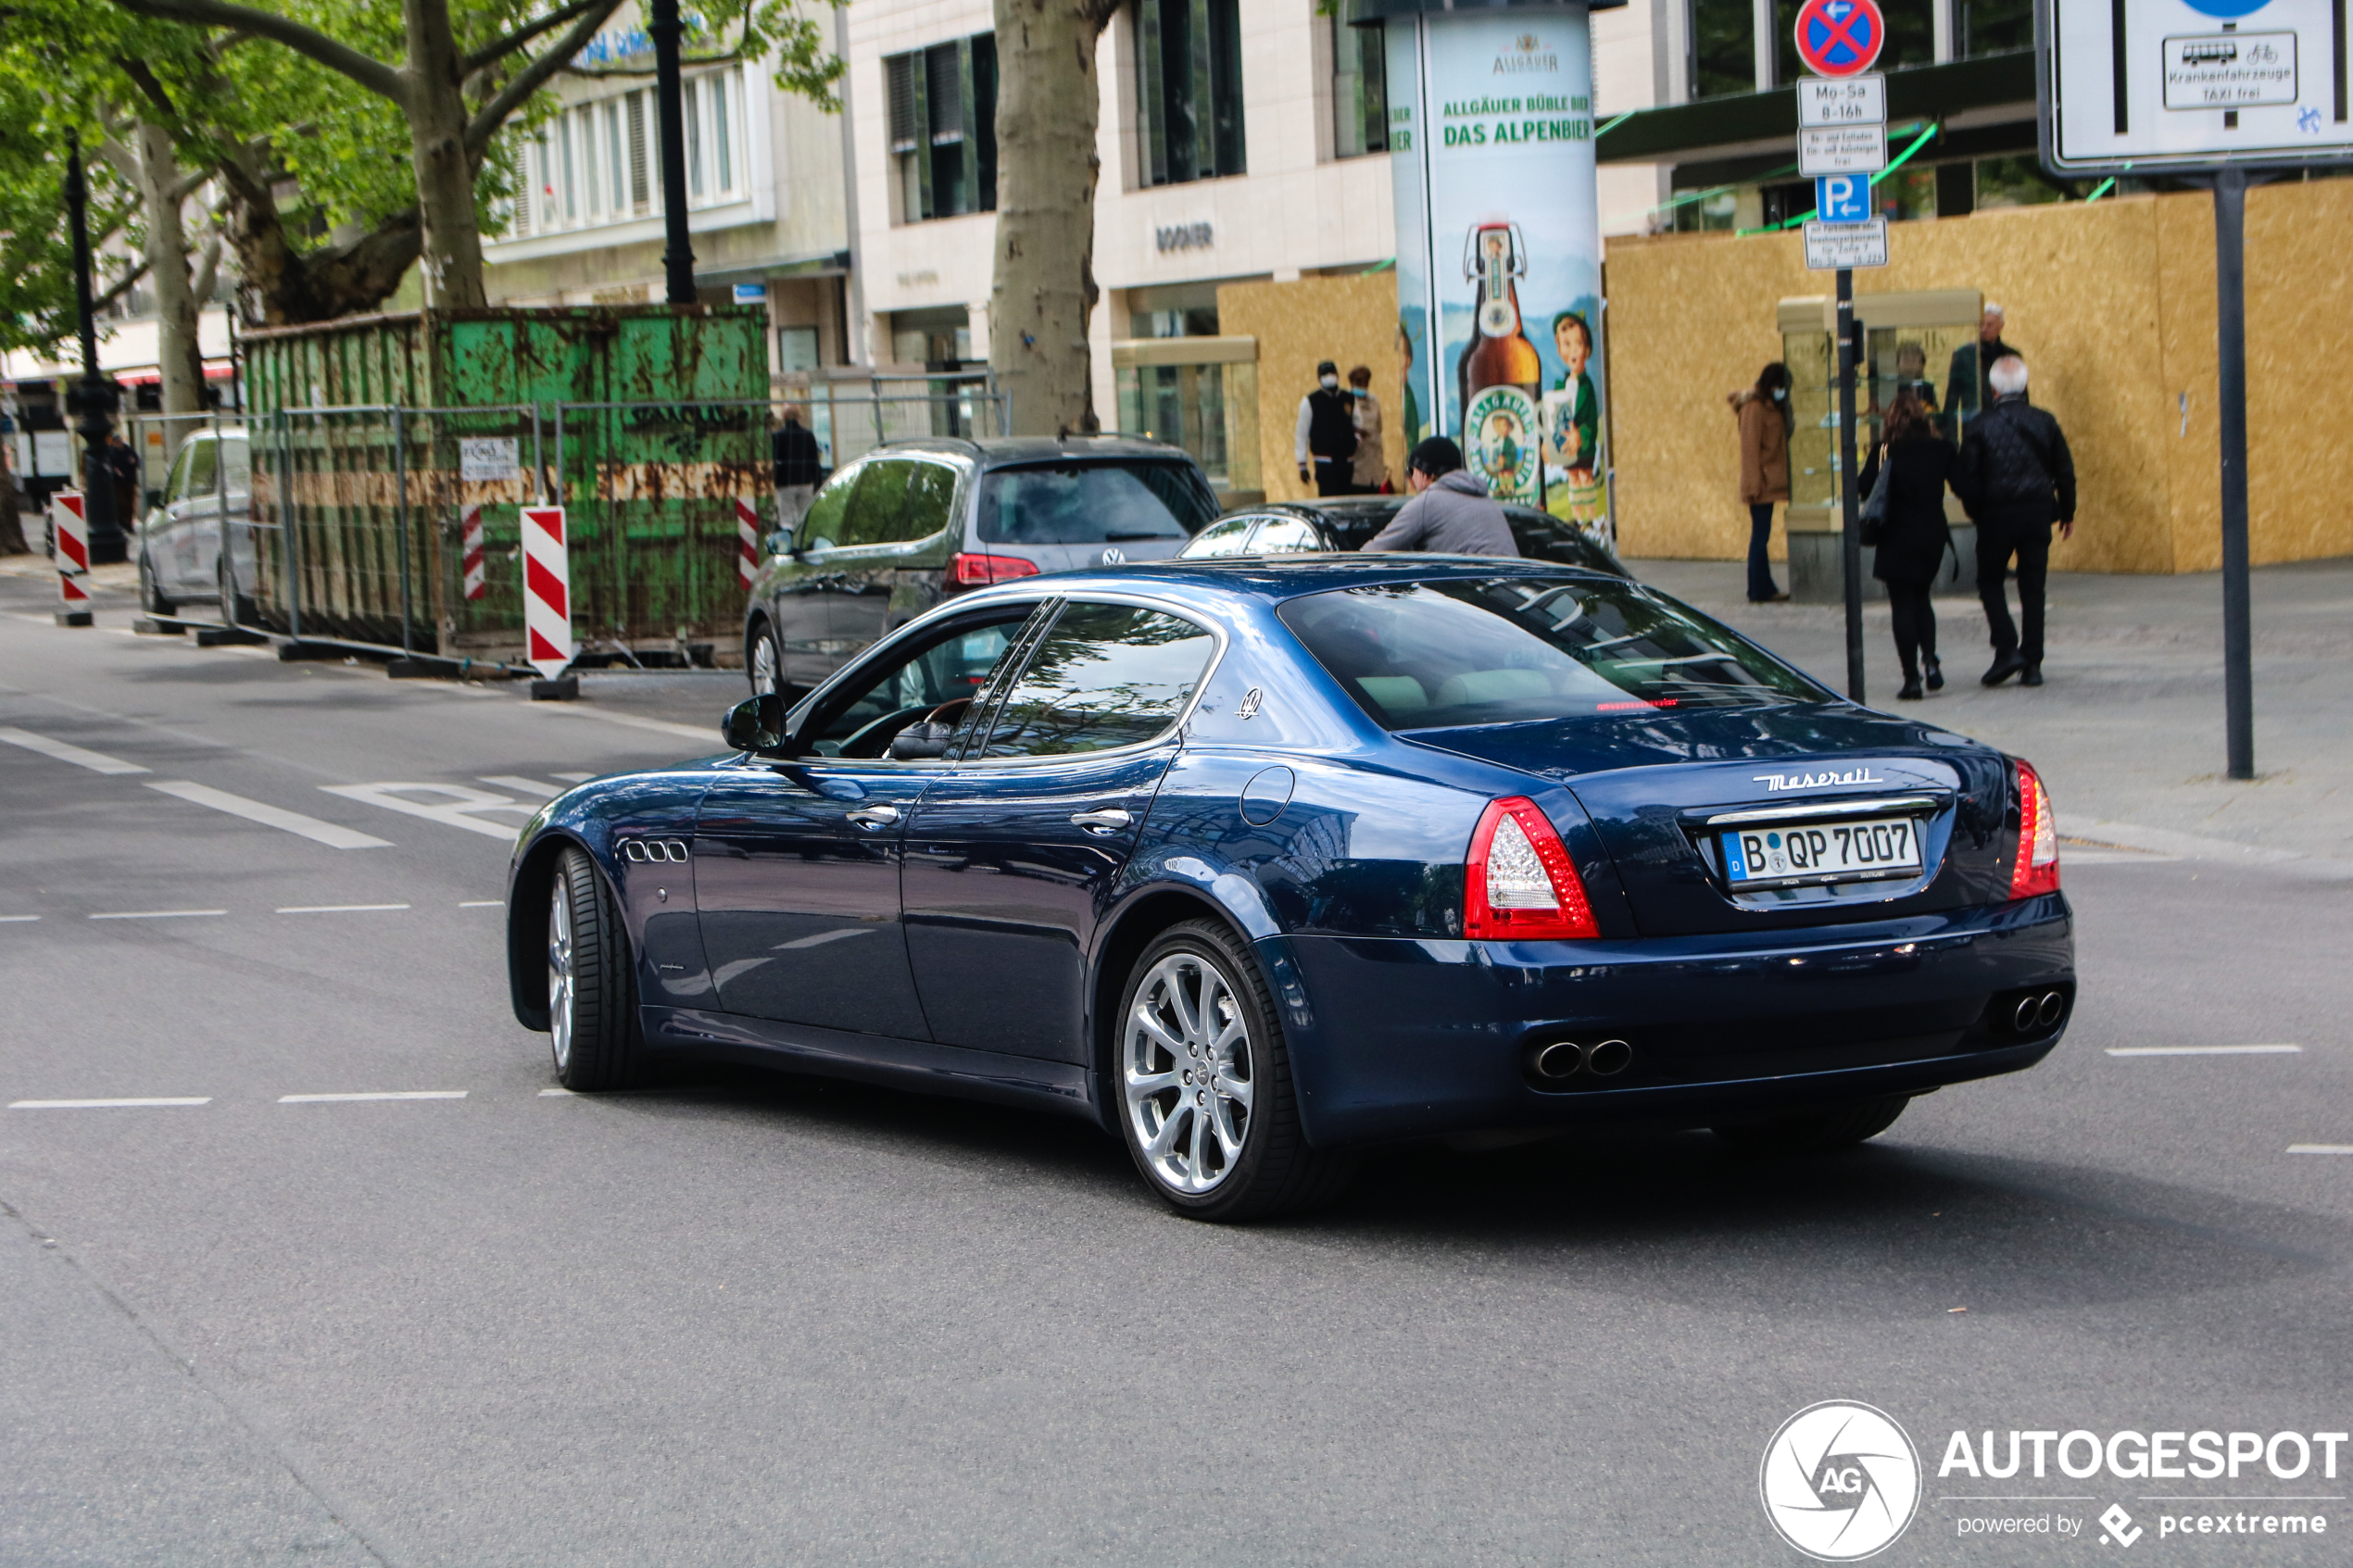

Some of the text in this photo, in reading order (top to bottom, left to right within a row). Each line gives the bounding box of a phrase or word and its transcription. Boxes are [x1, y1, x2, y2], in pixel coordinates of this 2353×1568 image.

[2169, 68, 2291, 85] Krankenfahrzeuge
[2203, 86, 2260, 102] TAXI frei
[1443, 94, 1589, 118] ALLGÄUER BÜBLE BIER
[1444, 119, 1591, 147] DAS ALPENBIER
[1826, 132, 1840, 143] und
[1842, 131, 1873, 143] Entladen
[1824, 144, 1837, 156] und
[1840, 144, 1879, 157] Aussteigen
[1834, 156, 1852, 167] frei
[1825, 176, 1854, 218] P
[1753, 768, 1883, 792] Maserati
[1743, 823, 1908, 872] B QP 7007
[1731, 860, 1741, 872] D
